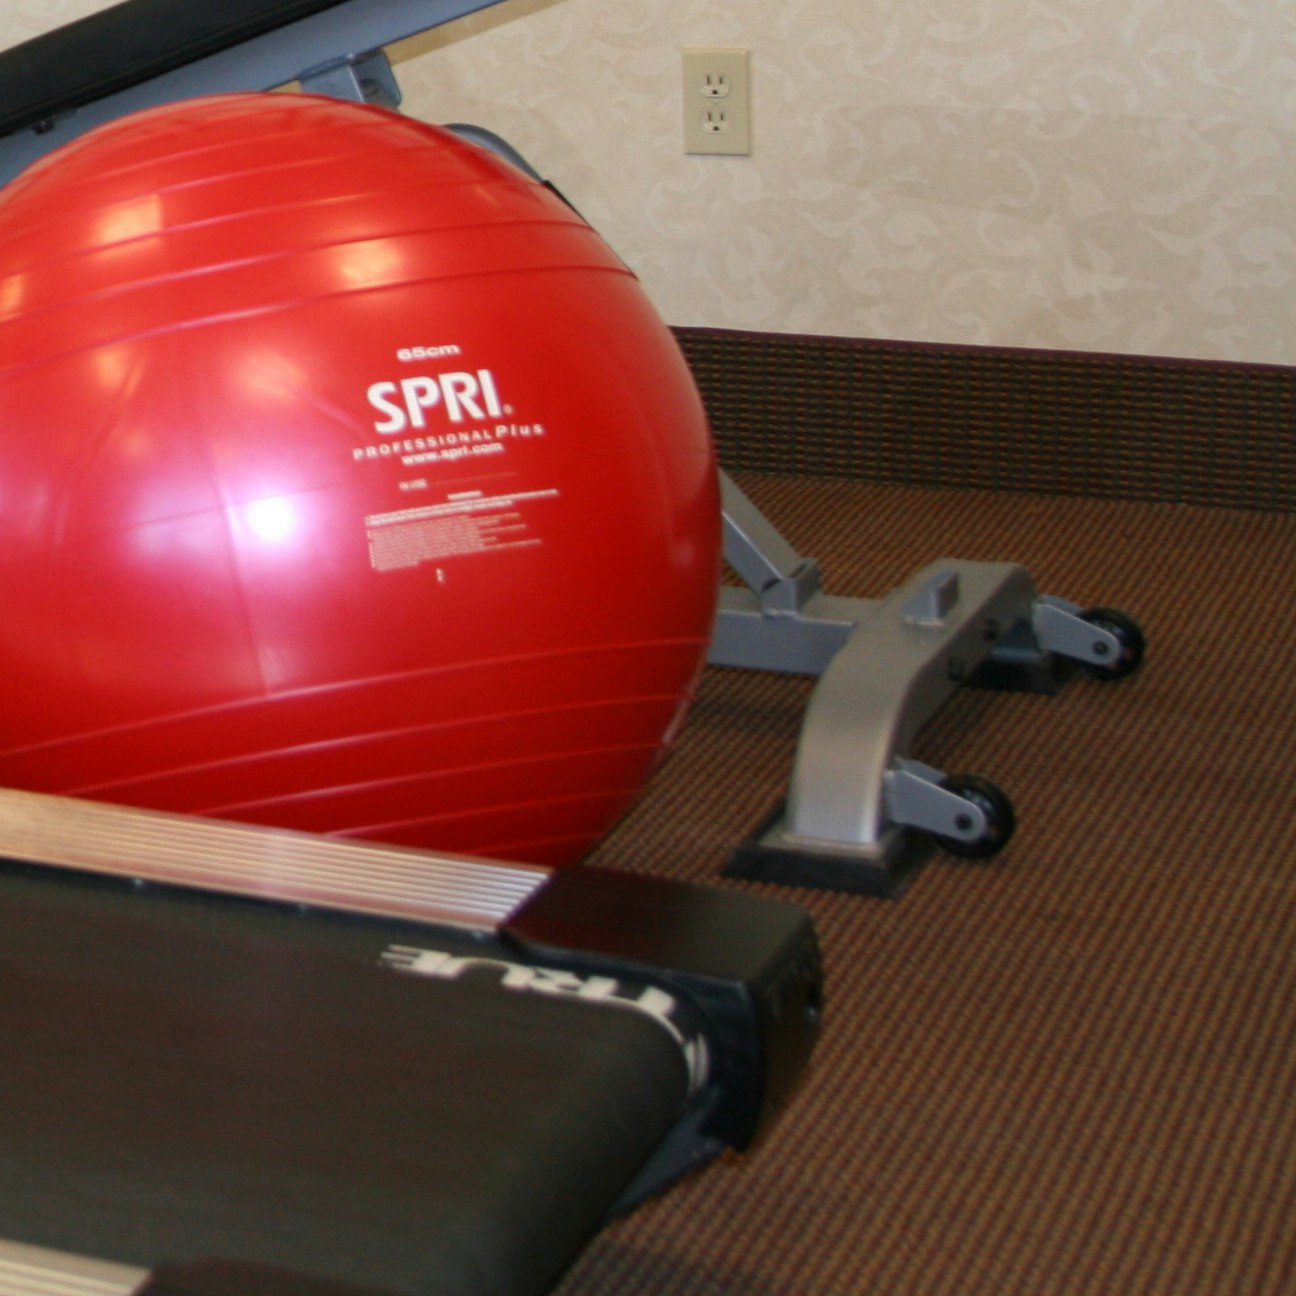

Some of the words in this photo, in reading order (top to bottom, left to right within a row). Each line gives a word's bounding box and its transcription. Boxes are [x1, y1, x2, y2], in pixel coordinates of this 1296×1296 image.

[397, 344, 460, 362] 65cm
[367, 369, 502, 435] SPRI
[353, 430, 491, 460] PROFESSIONAL
[495, 424, 544, 438] Plus
[401, 442, 504, 466] www.spri.com
